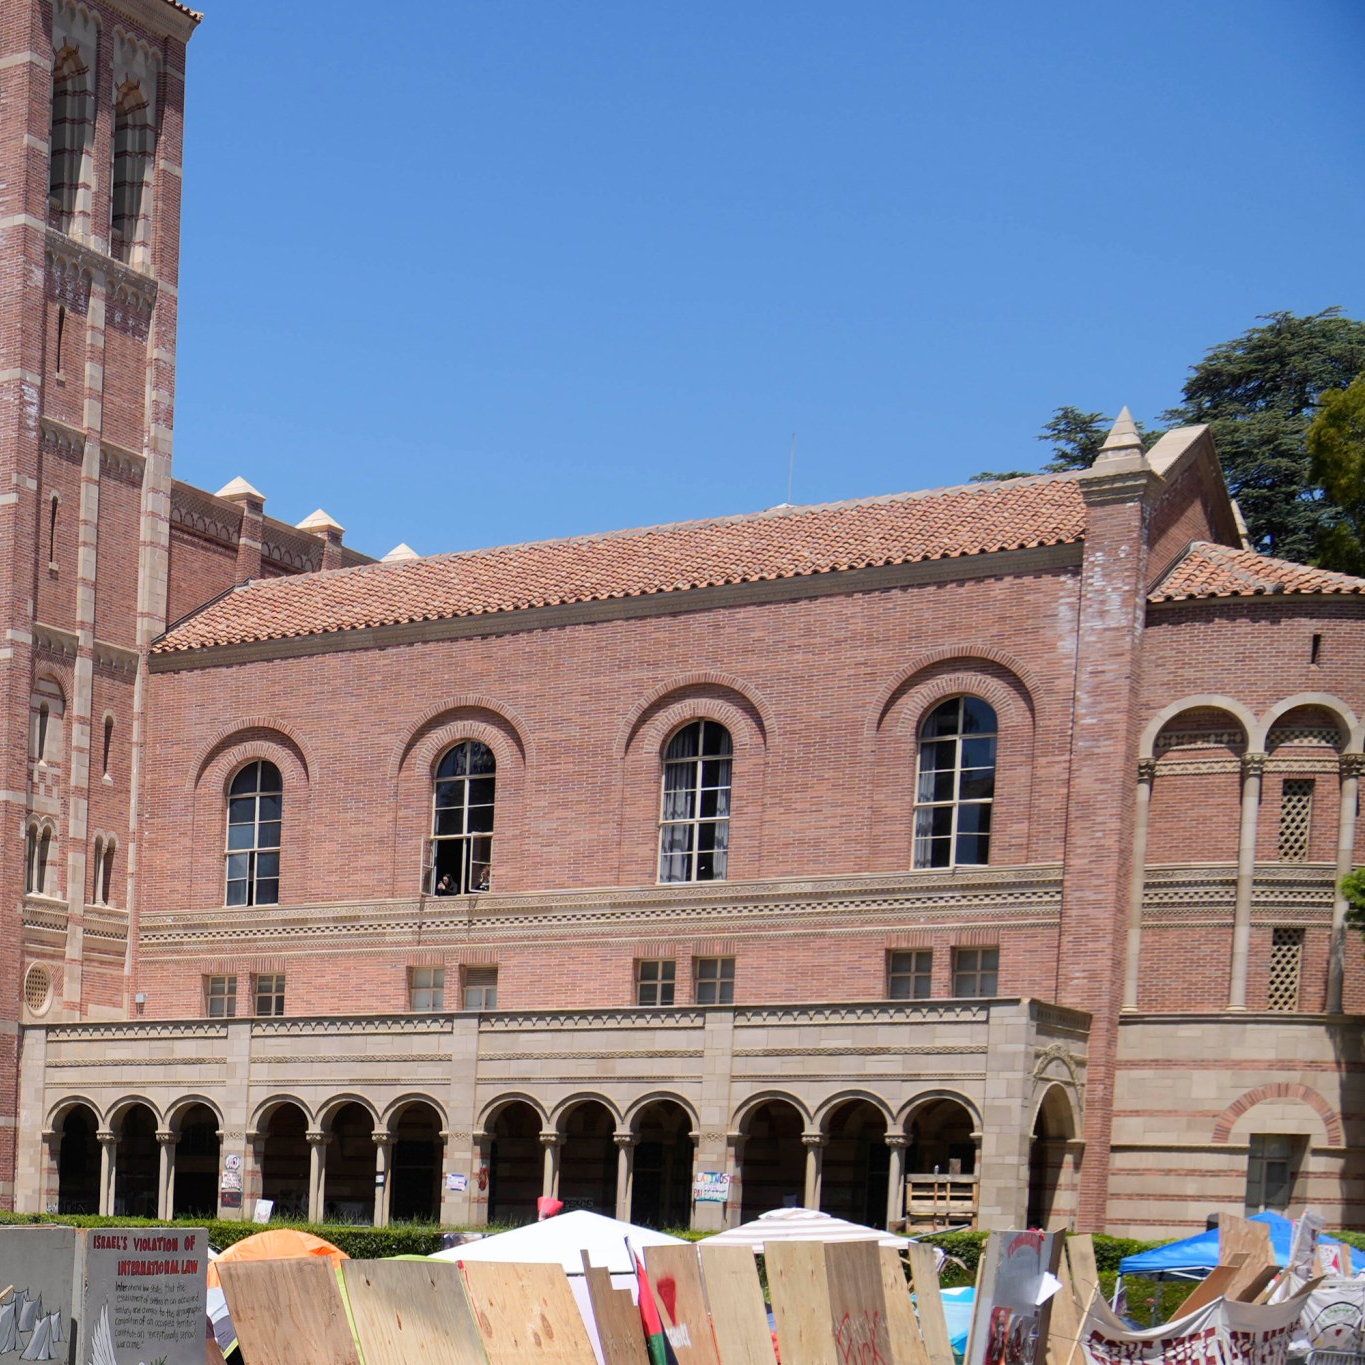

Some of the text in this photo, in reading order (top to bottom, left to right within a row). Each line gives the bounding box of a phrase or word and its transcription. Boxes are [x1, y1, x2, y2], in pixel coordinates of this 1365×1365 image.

[93, 1235, 196, 1252] ISRAEL'S VIOLATION OF
[117, 1260, 198, 1276] INTERNATIONAL LAW
